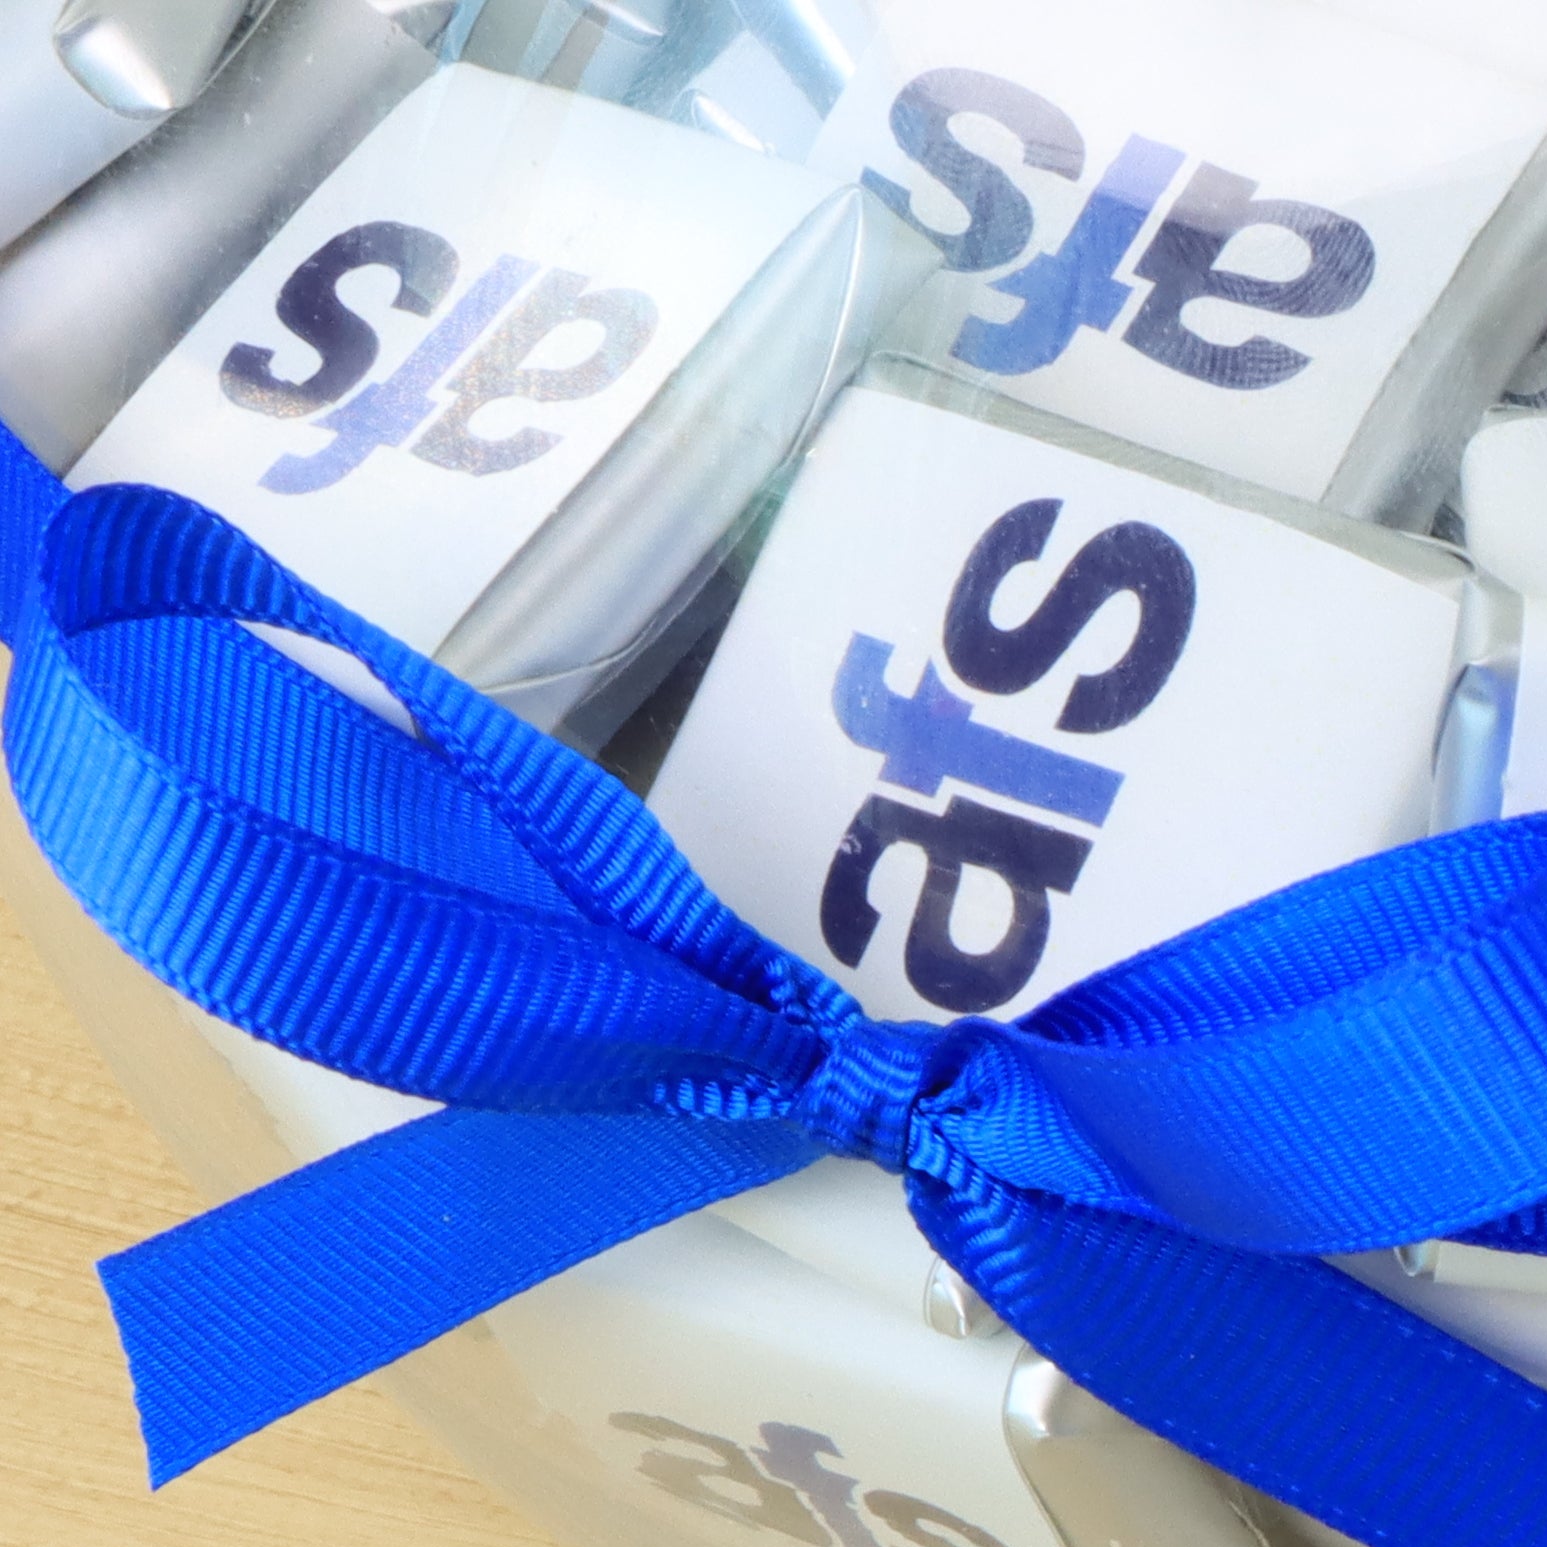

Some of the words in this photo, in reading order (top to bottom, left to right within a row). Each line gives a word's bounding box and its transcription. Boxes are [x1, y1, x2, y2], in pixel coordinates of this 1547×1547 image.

[218, 220, 660, 495] afs
[858, 67, 1376, 390] afs
[820, 497, 1197, 1014] afs
